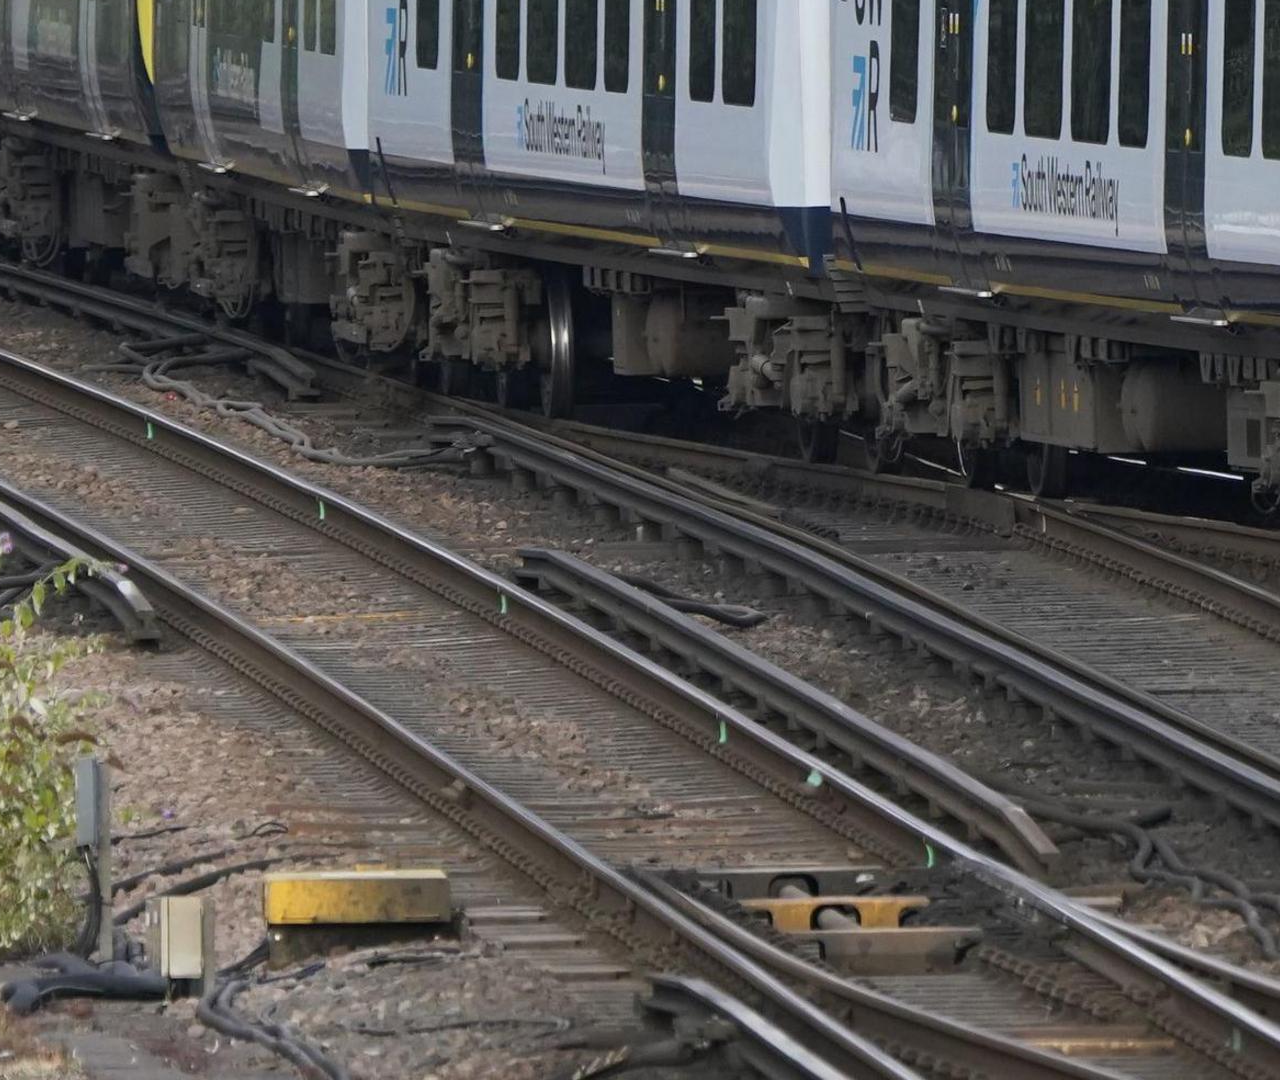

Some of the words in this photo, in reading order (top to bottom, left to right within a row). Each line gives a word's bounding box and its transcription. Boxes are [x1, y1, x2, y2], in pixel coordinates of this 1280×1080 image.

[524, 98, 545, 152] South
[577, 104, 607, 175] Railway
[867, 40, 880, 153] R
[1020, 153, 1048, 214] South
[1047, 156, 1084, 217] Western
[1085, 160, 1120, 237] Railway
